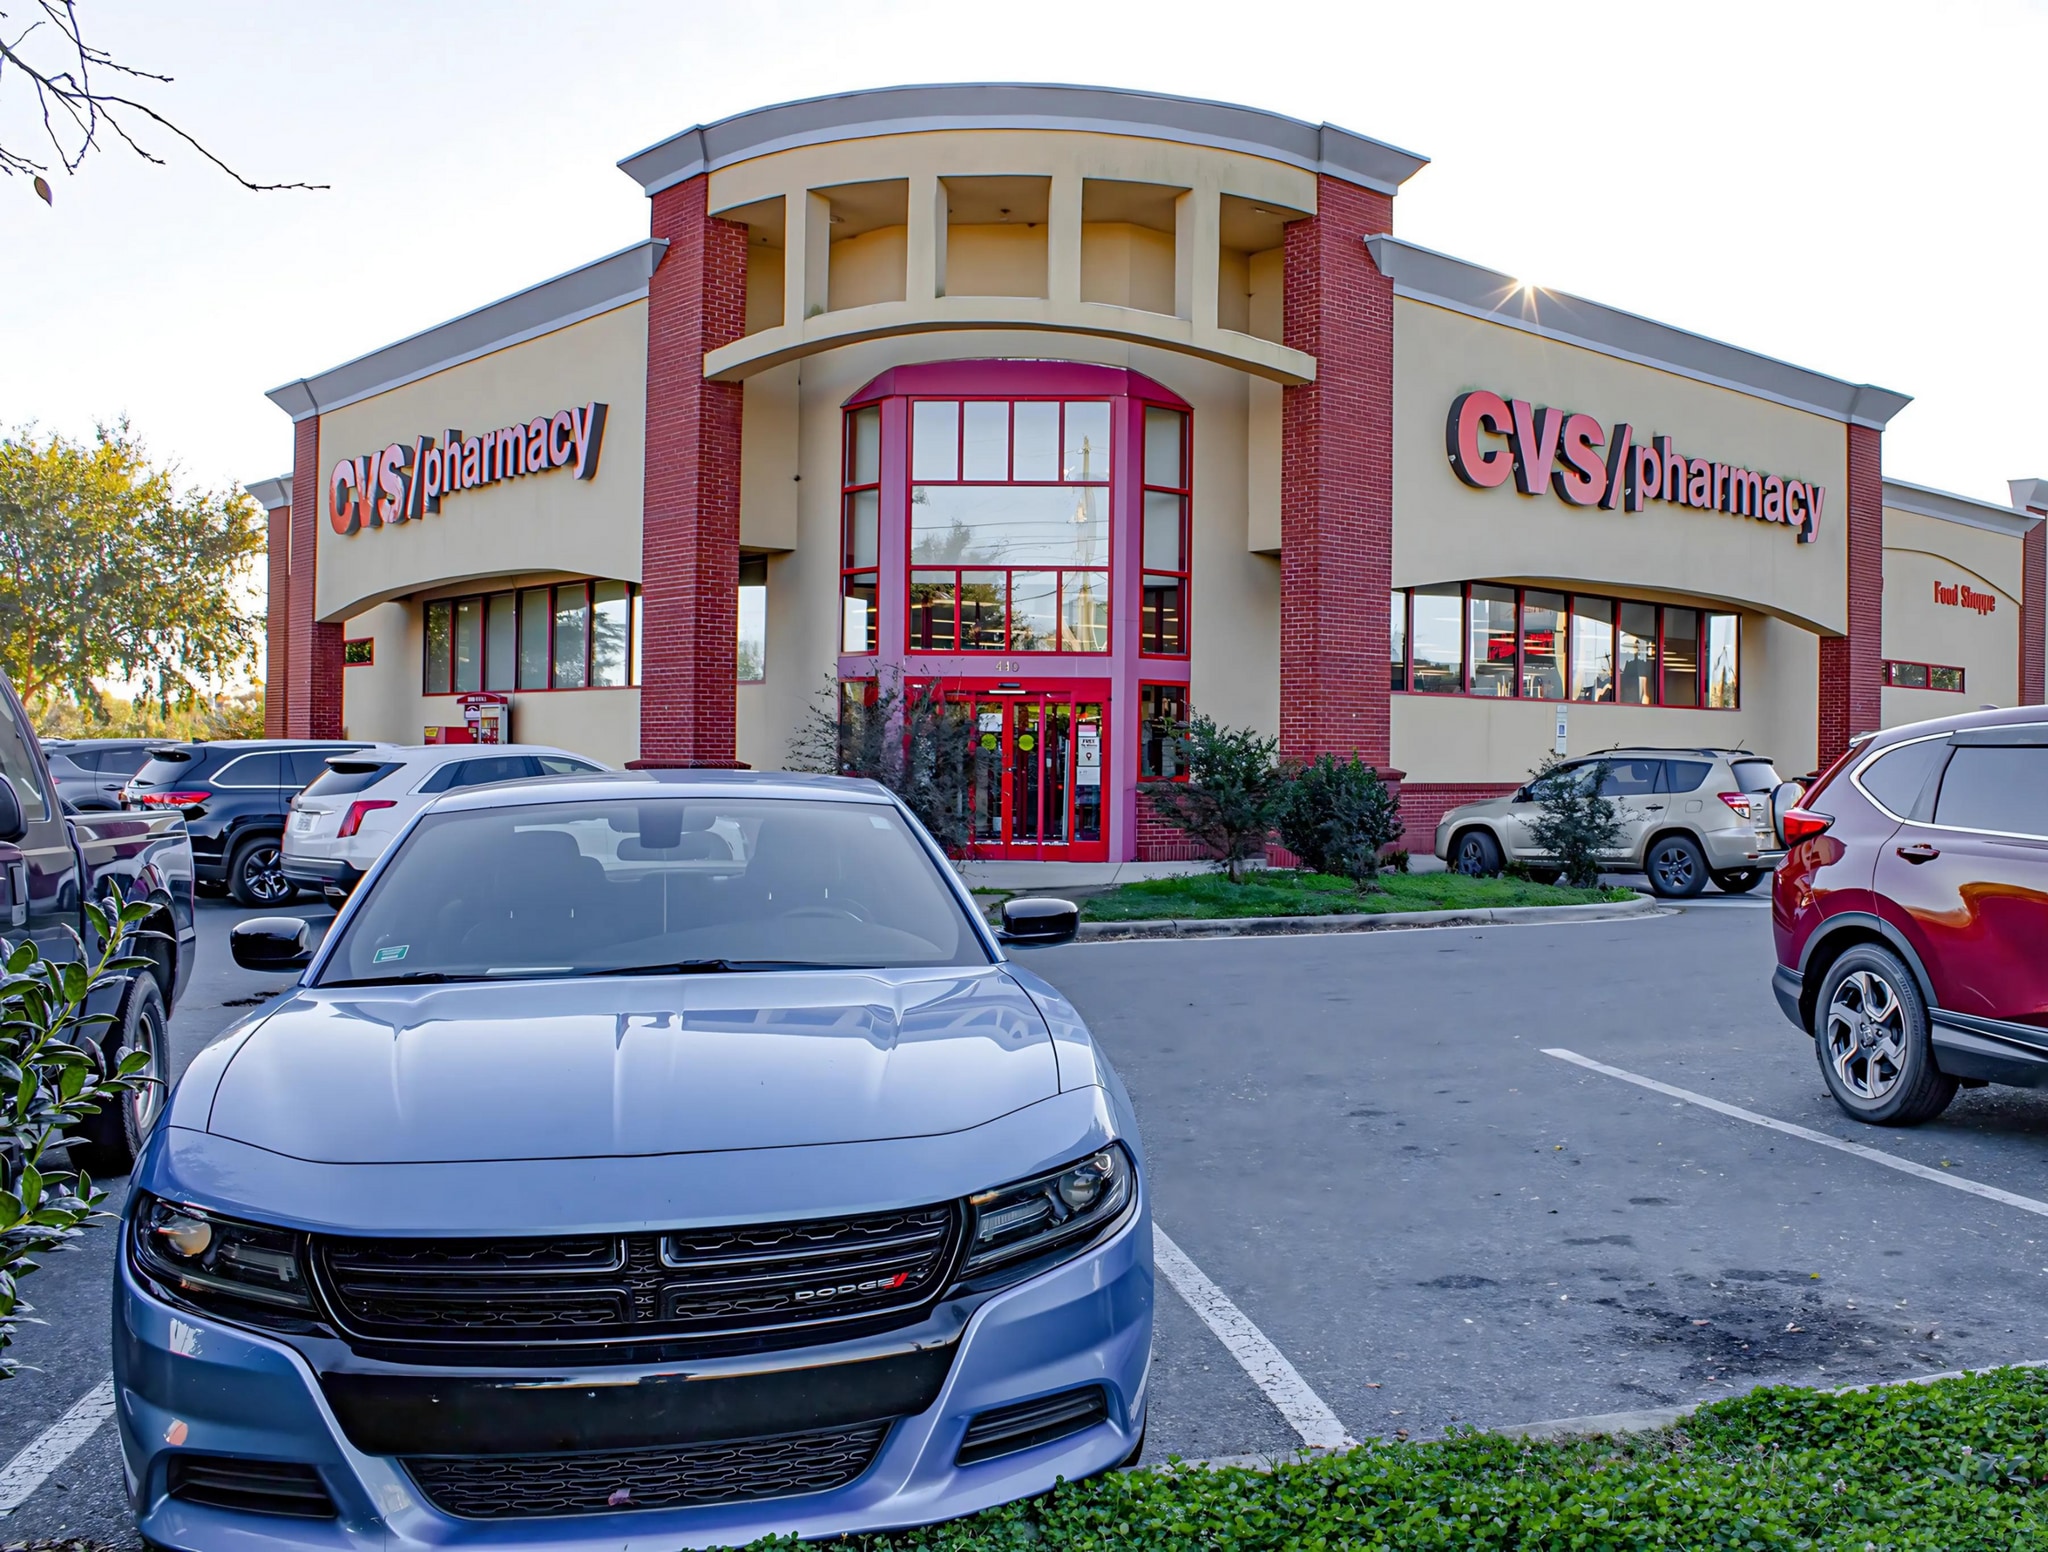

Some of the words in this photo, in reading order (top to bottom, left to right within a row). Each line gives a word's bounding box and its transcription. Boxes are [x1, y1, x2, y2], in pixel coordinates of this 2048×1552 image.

[329, 402, 609, 535] CVS/pharmacy
[1446, 390, 1825, 543] CVS/pharmacy
[1934, 580, 1958, 606] Food
[795, 1277, 895, 1300] DODGE
